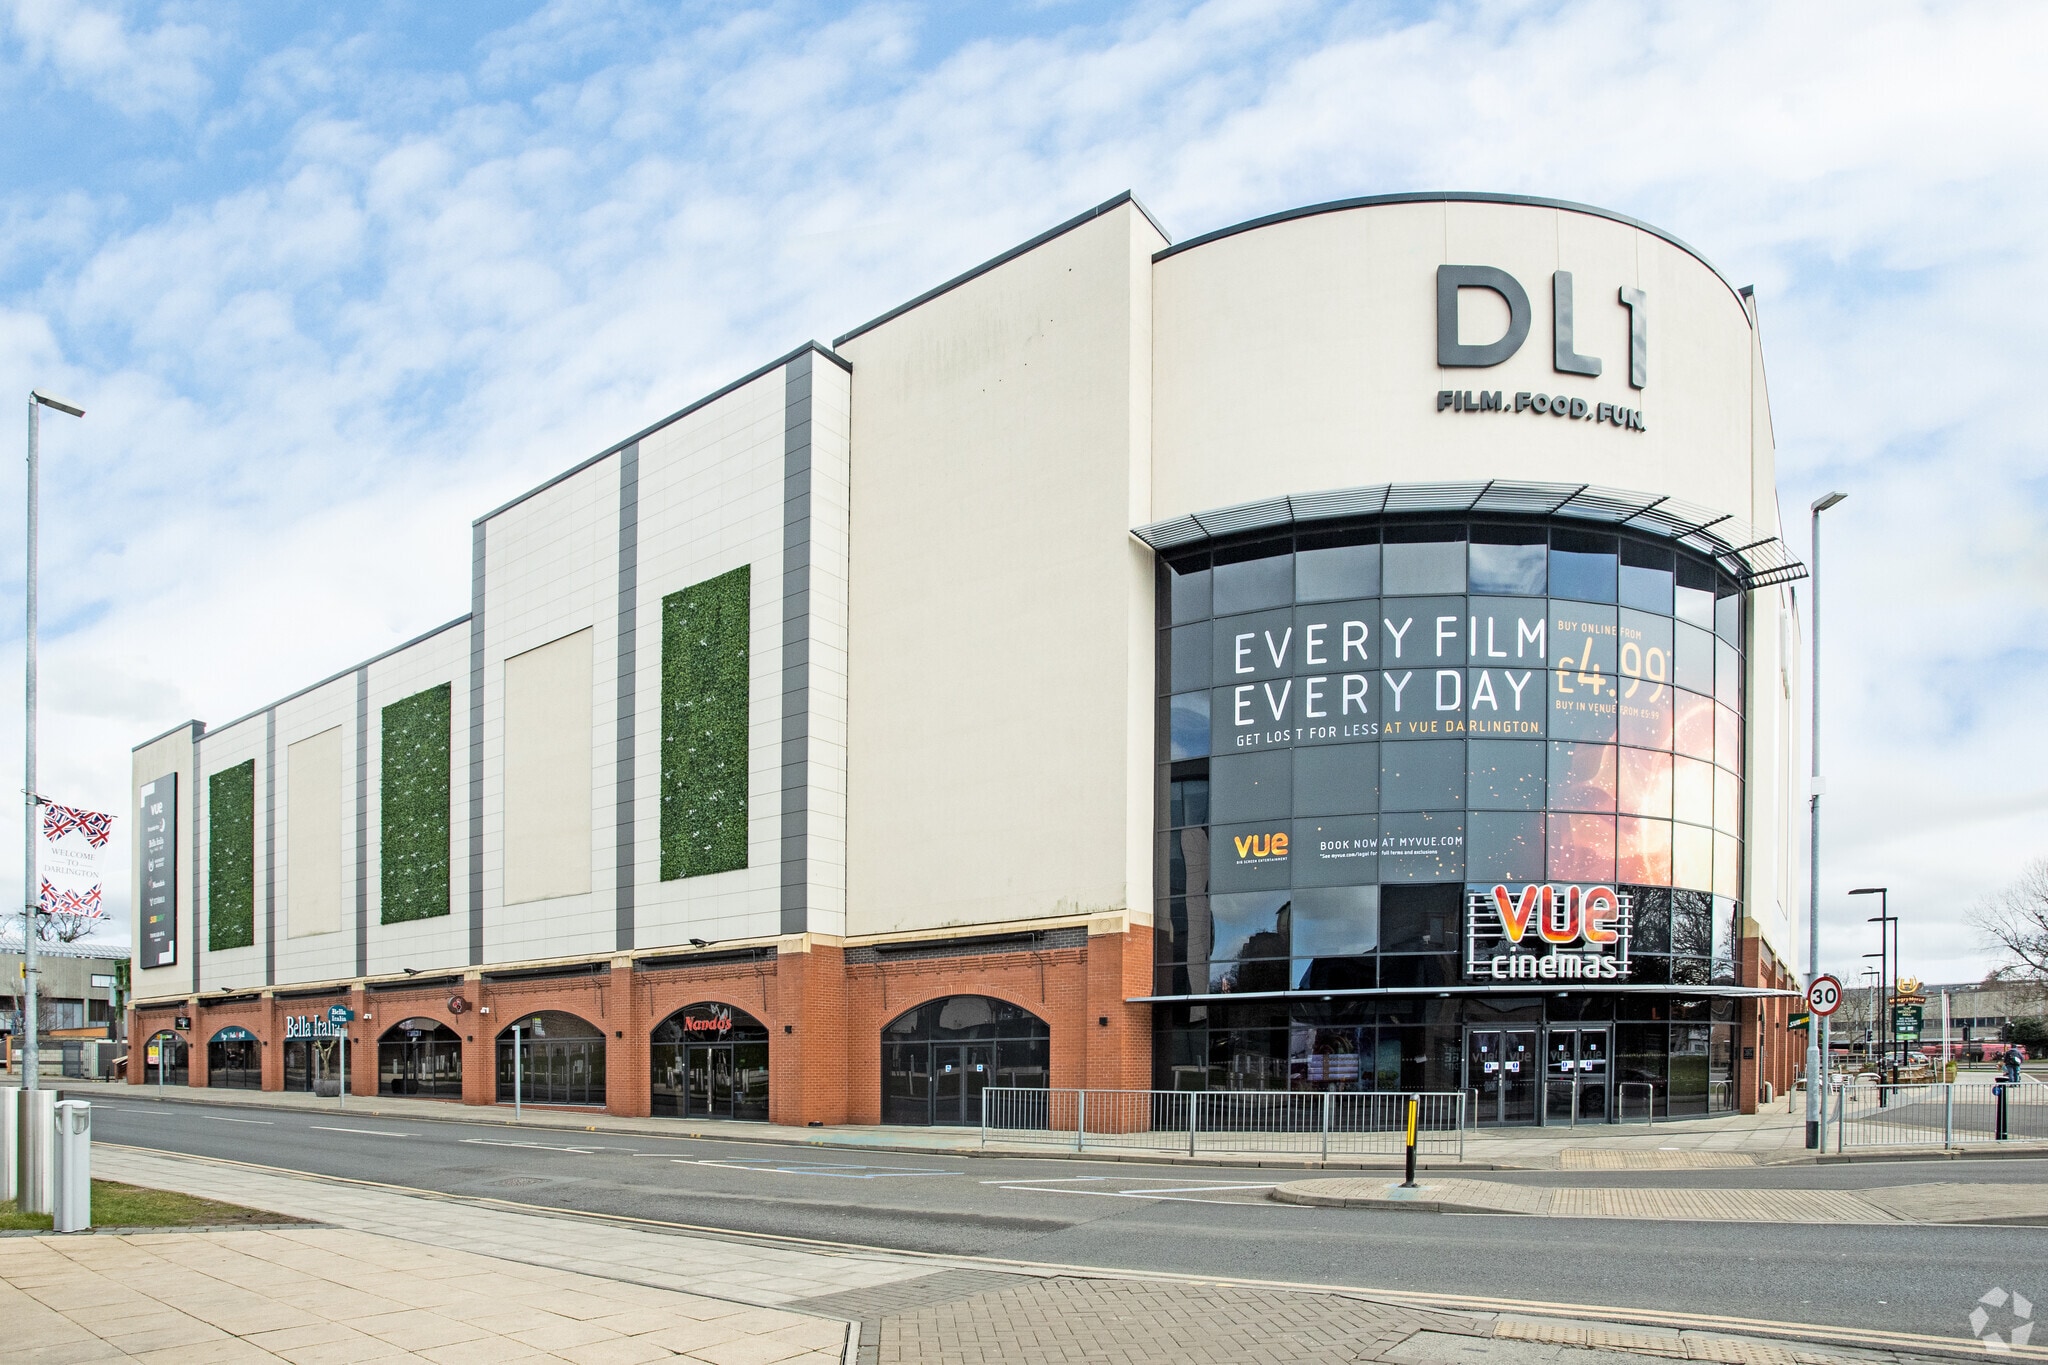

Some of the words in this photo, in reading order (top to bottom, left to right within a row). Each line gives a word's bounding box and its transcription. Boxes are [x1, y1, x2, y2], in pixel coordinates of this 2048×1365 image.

[1437, 264, 1647, 389] DL1
[1558, 620, 1578, 631] BUY
[1581, 623, 1617, 636] ONLINE
[1620, 627, 1642, 640] FROM
[1235, 617, 1413, 674] EVERY
[1436, 615, 1545, 659] FILM
[1234, 671, 1413, 726] EVERY
[1436, 670, 1532, 712] DAY
[1556, 700, 1574, 710] BUY
[1576, 702, 1586, 711] IN
[1588, 702, 1617, 714] VENUE
[1620, 705, 1639, 716] FROM
[1236, 733, 1260, 746] GET
[1266, 728, 1303, 743] LOST
[1309, 726, 1337, 739] FOR
[1344, 723, 1378, 736] LESS
[1384, 722, 1402, 734] AT
[1409, 721, 1438, 733] VUE
[51, 847, 96, 860] WELCOME
[1234, 832, 1289, 859] vue
[1320, 840, 1350, 851] BOOK
[1354, 838, 1378, 849] NOW
[1381, 837, 1395, 847] AT
[1400, 836, 1463, 847] MYVUE.COM
[44, 864, 100, 878] DARLINGTON
[1491, 884, 1619, 944] vue
[1492, 946, 1617, 979] cinemas
[1812, 988, 1837, 1005] 30
[286, 1015, 311, 1038] Bella
[313, 1014, 340, 1037] Itali
[684, 1016, 732, 1031] Nando's
